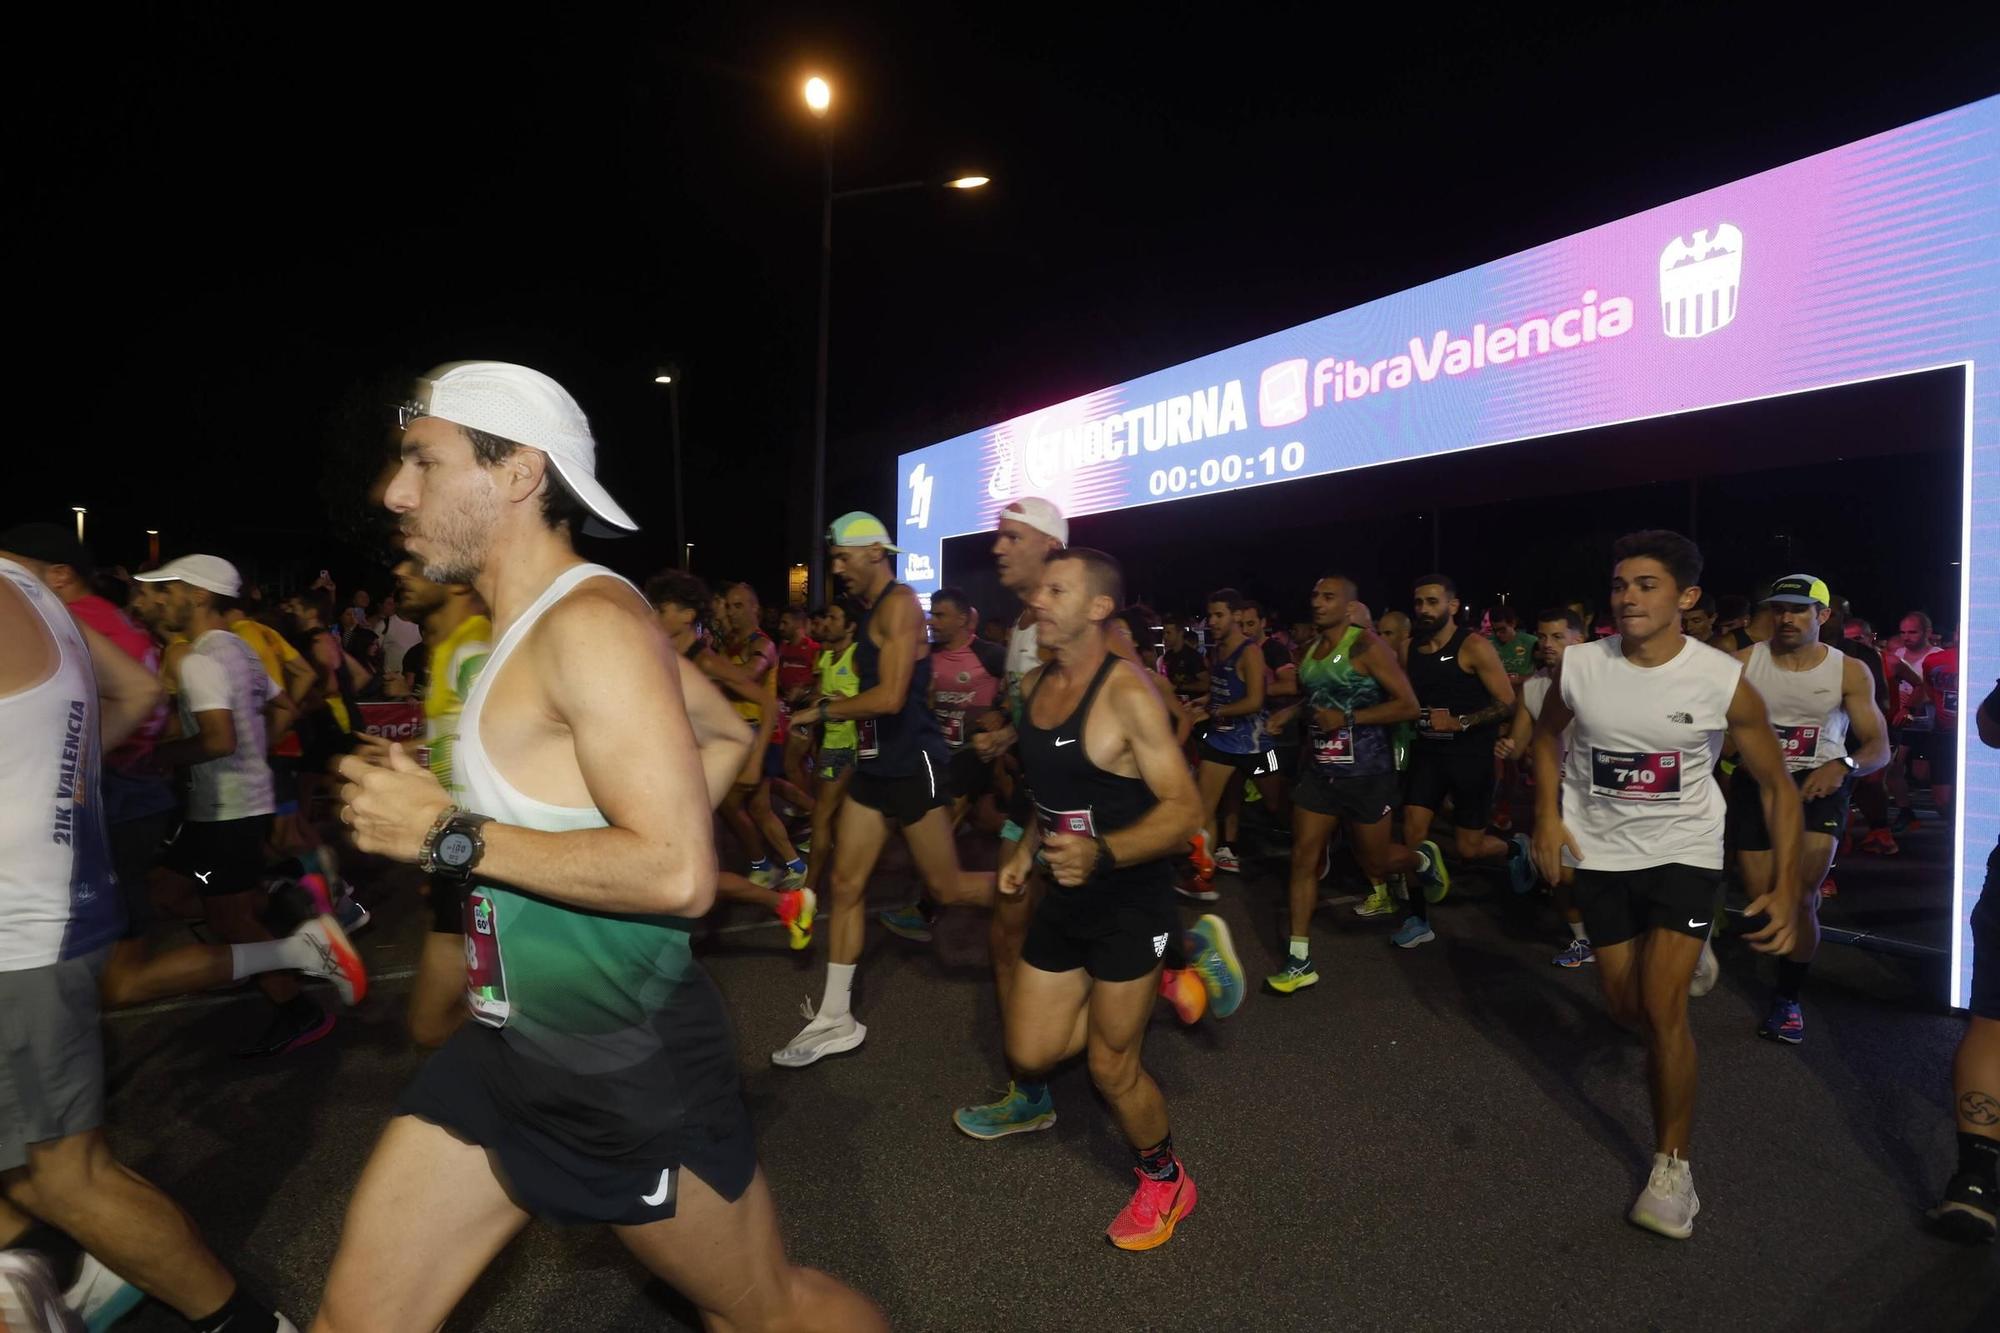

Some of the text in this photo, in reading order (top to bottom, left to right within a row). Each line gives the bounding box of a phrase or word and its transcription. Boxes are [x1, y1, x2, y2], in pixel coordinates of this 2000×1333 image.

[1064, 379, 1248, 470] NOCTURNA
[1149, 441, 1305, 496] 00:00:10
[56, 700, 86, 799] VALENCIA
[1613, 767, 1656, 785] 710
[52, 805, 73, 848] 21K
